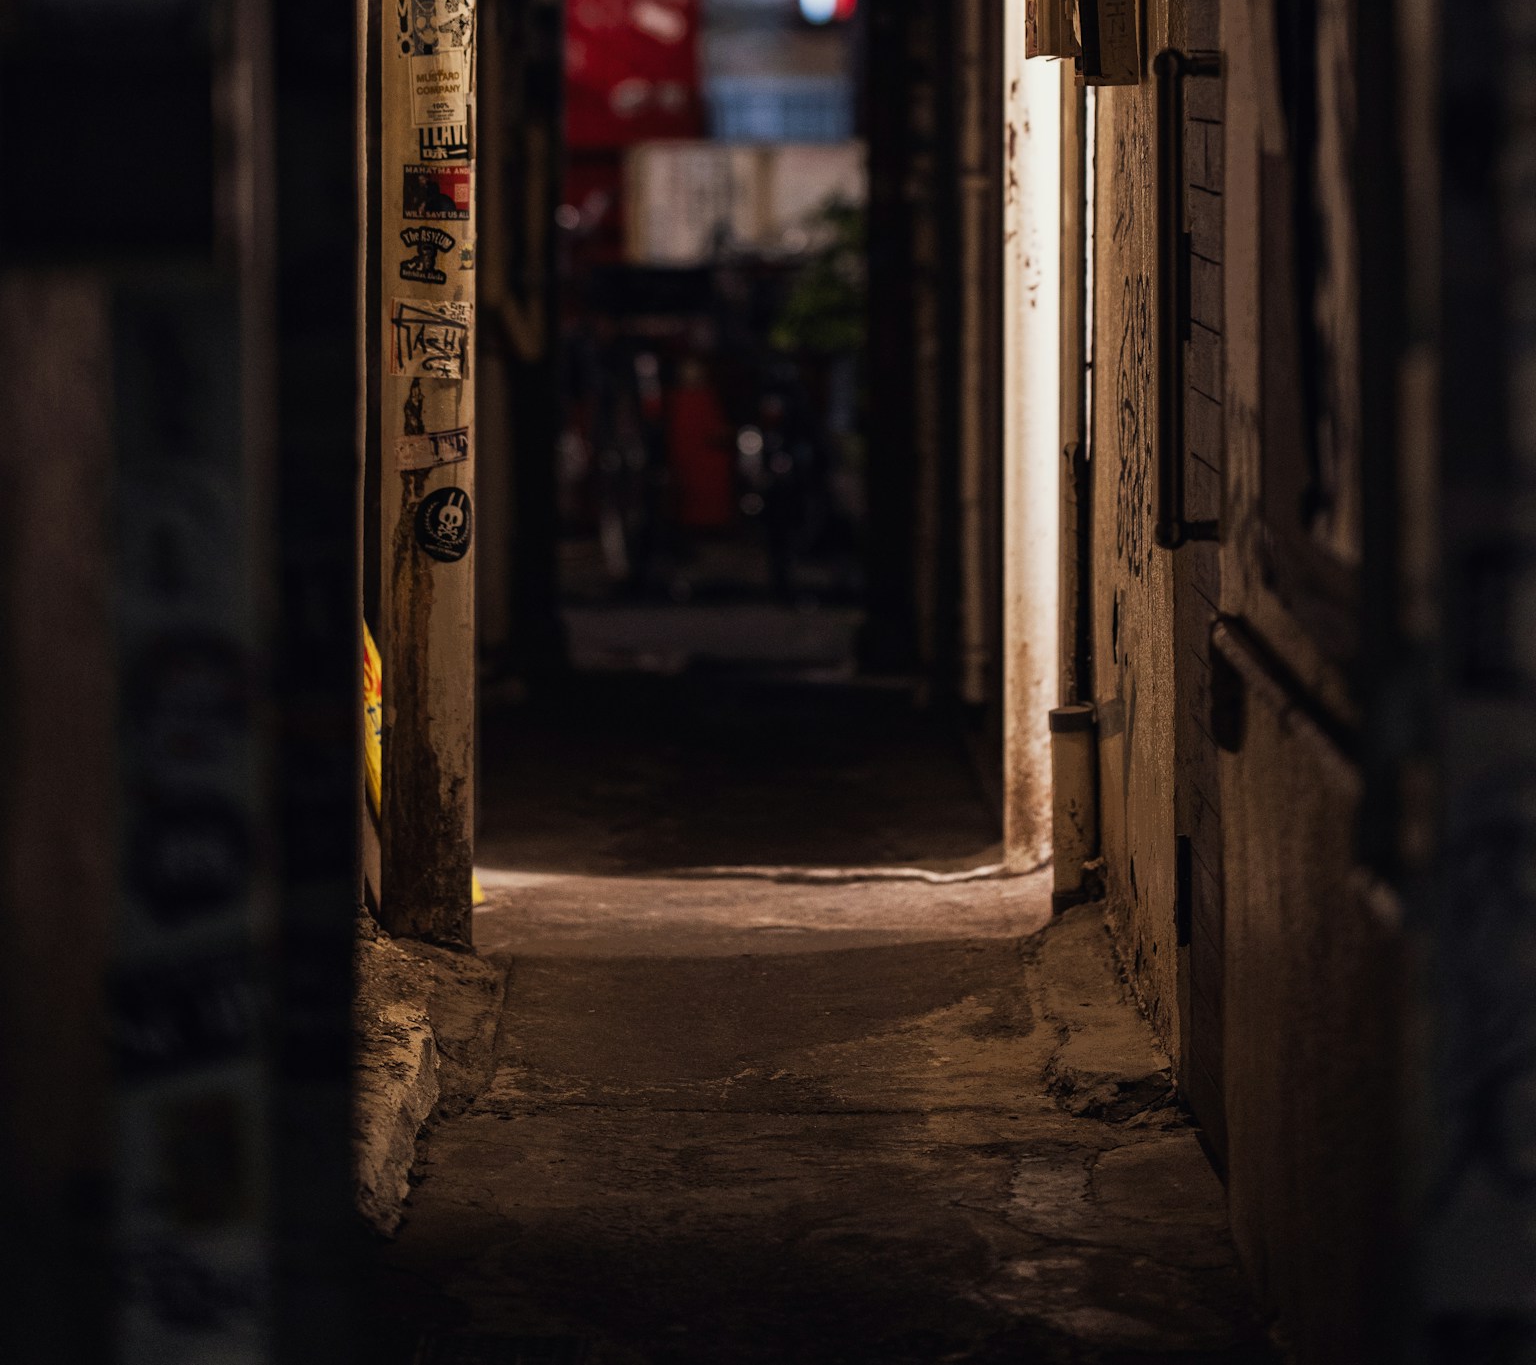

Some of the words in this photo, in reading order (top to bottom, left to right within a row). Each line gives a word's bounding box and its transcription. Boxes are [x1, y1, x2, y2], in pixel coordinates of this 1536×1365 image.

[417, 72, 460, 83] MUSTARD
[417, 85, 461, 95] COMPANY
[405, 166, 452, 175] MAHATMA
[425, 210, 447, 219] SAVE
[448, 211, 458, 219] US
[421, 229, 453, 250] ASYLUM
